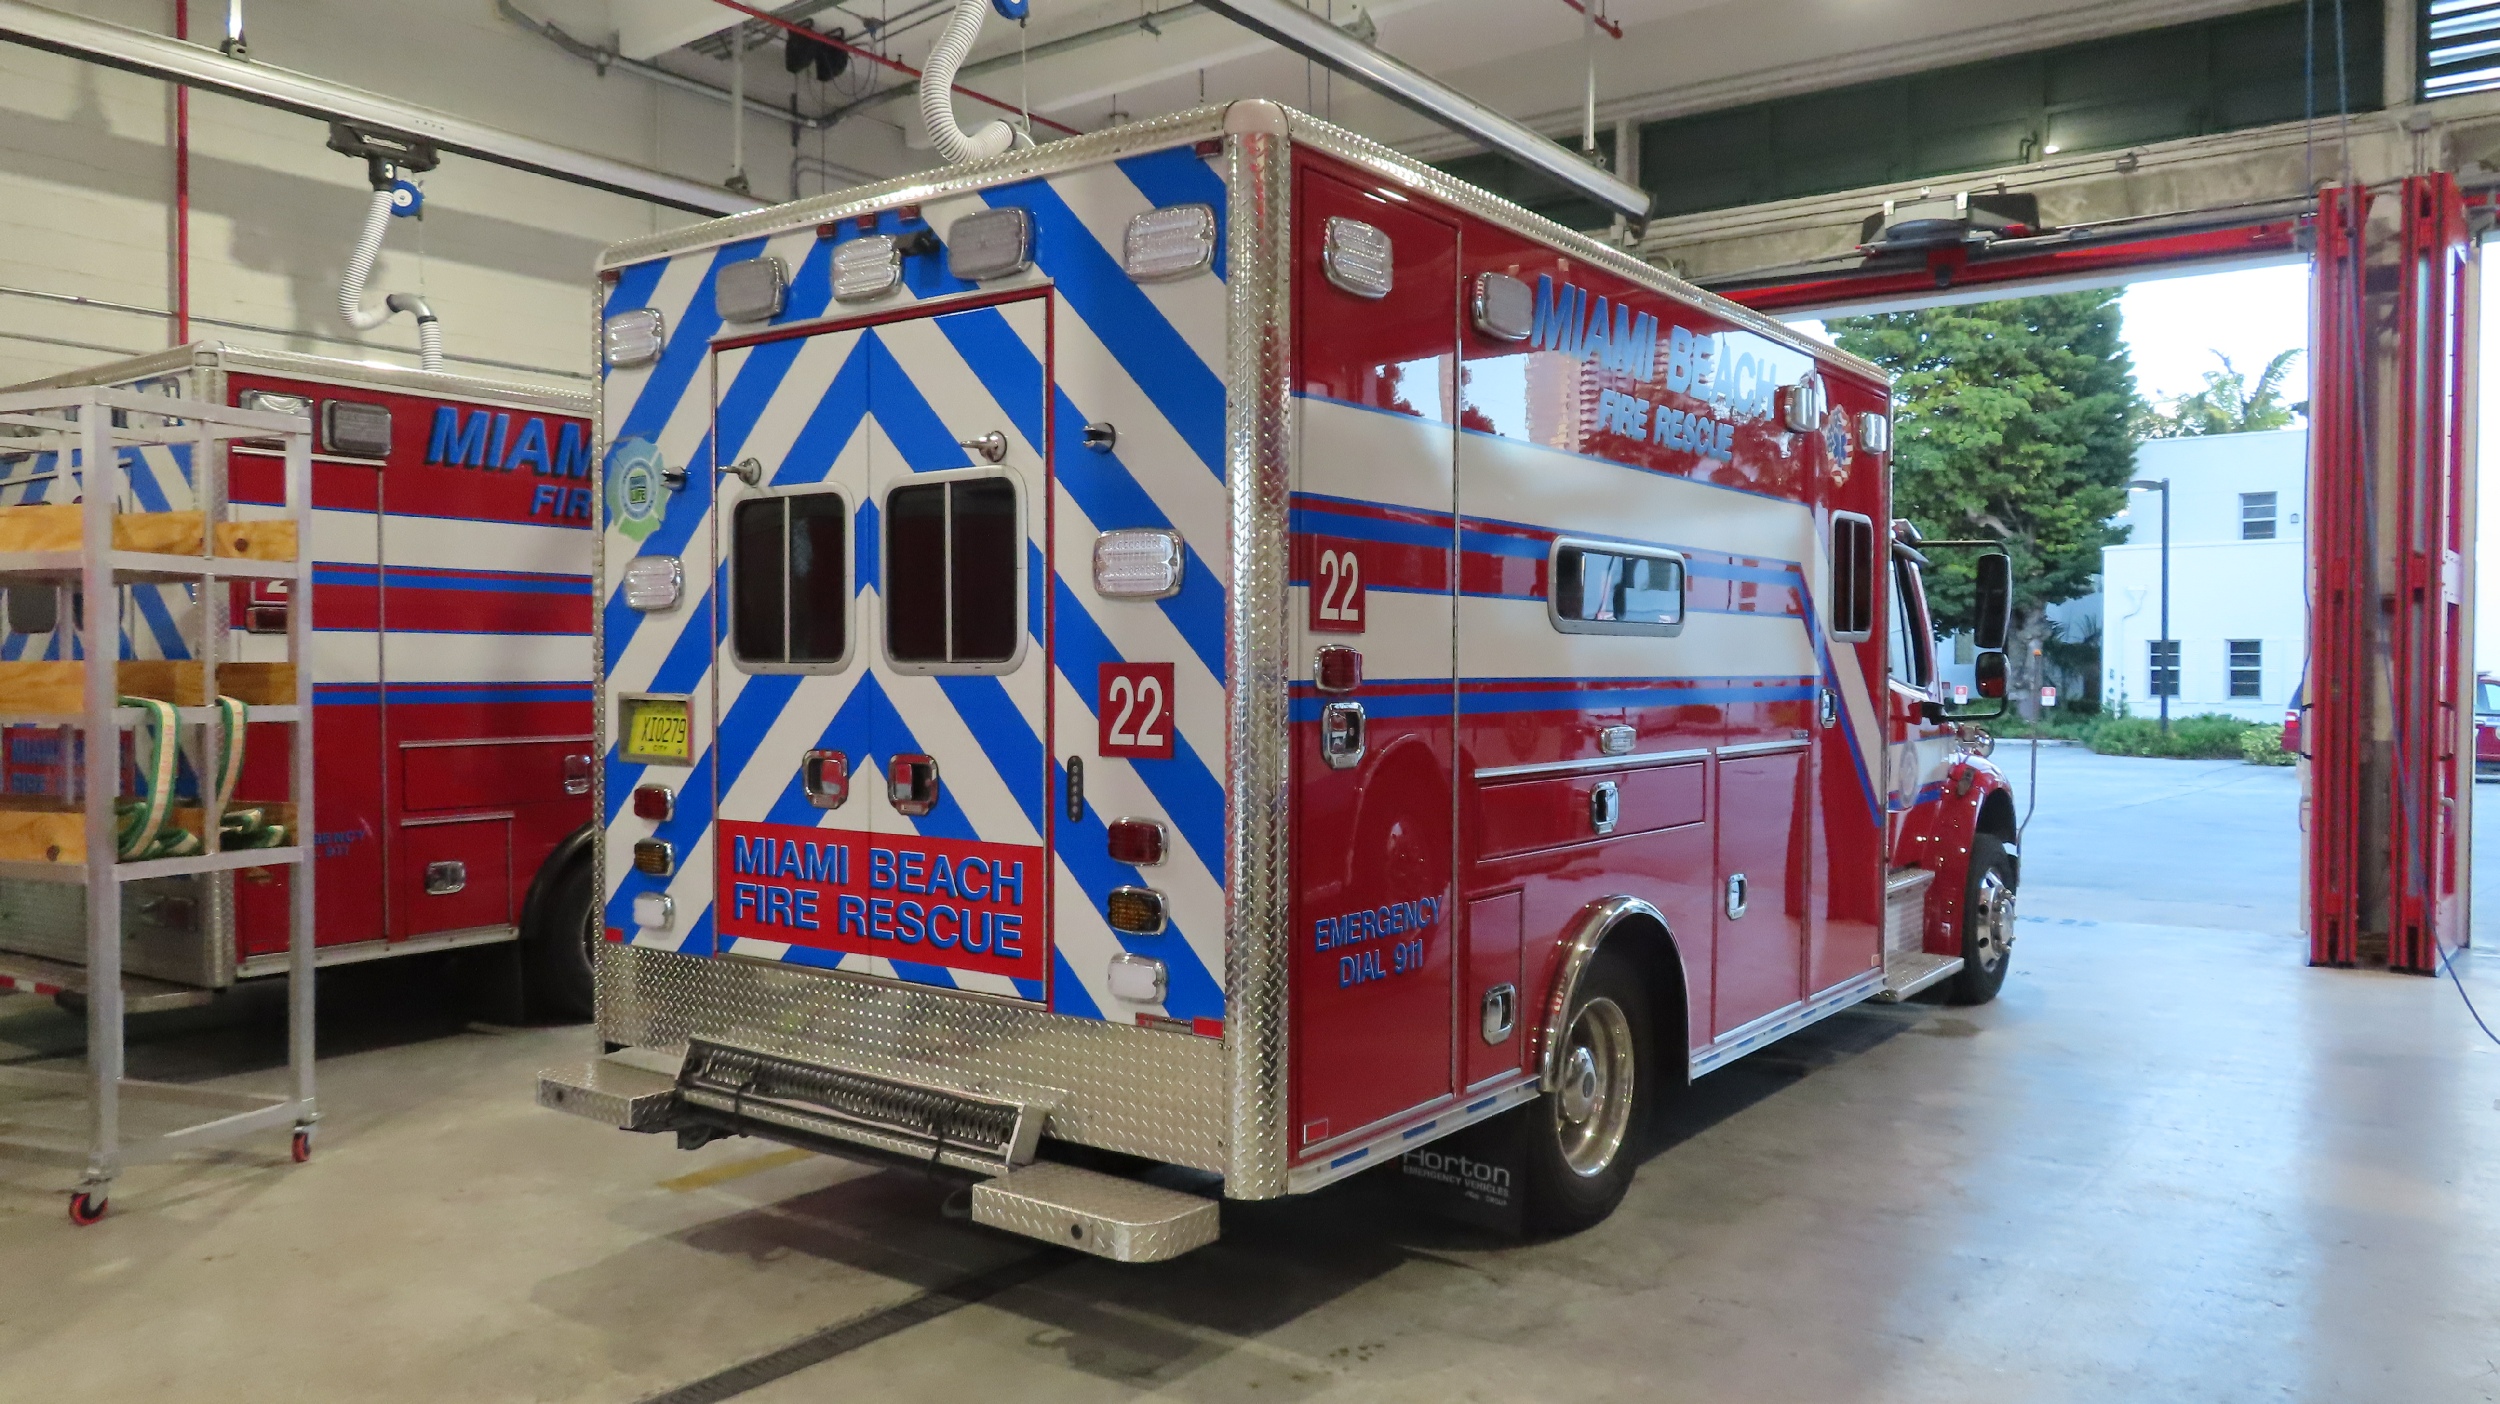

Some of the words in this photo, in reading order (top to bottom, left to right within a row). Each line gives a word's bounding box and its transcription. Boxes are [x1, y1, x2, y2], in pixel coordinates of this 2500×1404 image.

[384, 163, 395, 179] 3
[1530, 272, 1659, 383] MIAMI
[1666, 324, 1777, 422] BEACH
[1598, 388, 1650, 442] FIRE
[1653, 404, 1735, 463] RESCUE
[1319, 549, 1359, 622] 22
[1109, 675, 1164, 747] 22
[733, 834, 850, 885] MIAMI
[869, 847, 1024, 905] BEACH
[733, 882, 820, 930] FIRE
[838, 893, 1024, 958] RESCUE
[1315, 895, 1442, 952] EMERGENCY
[1339, 949, 1387, 988] DIAL
[1393, 938, 1424, 975] 911
[1403, 1149, 1511, 1187] Horton
[1403, 1164, 1462, 1185] EMERGENCY
[1464, 1178, 1509, 1198] VEHICLES
